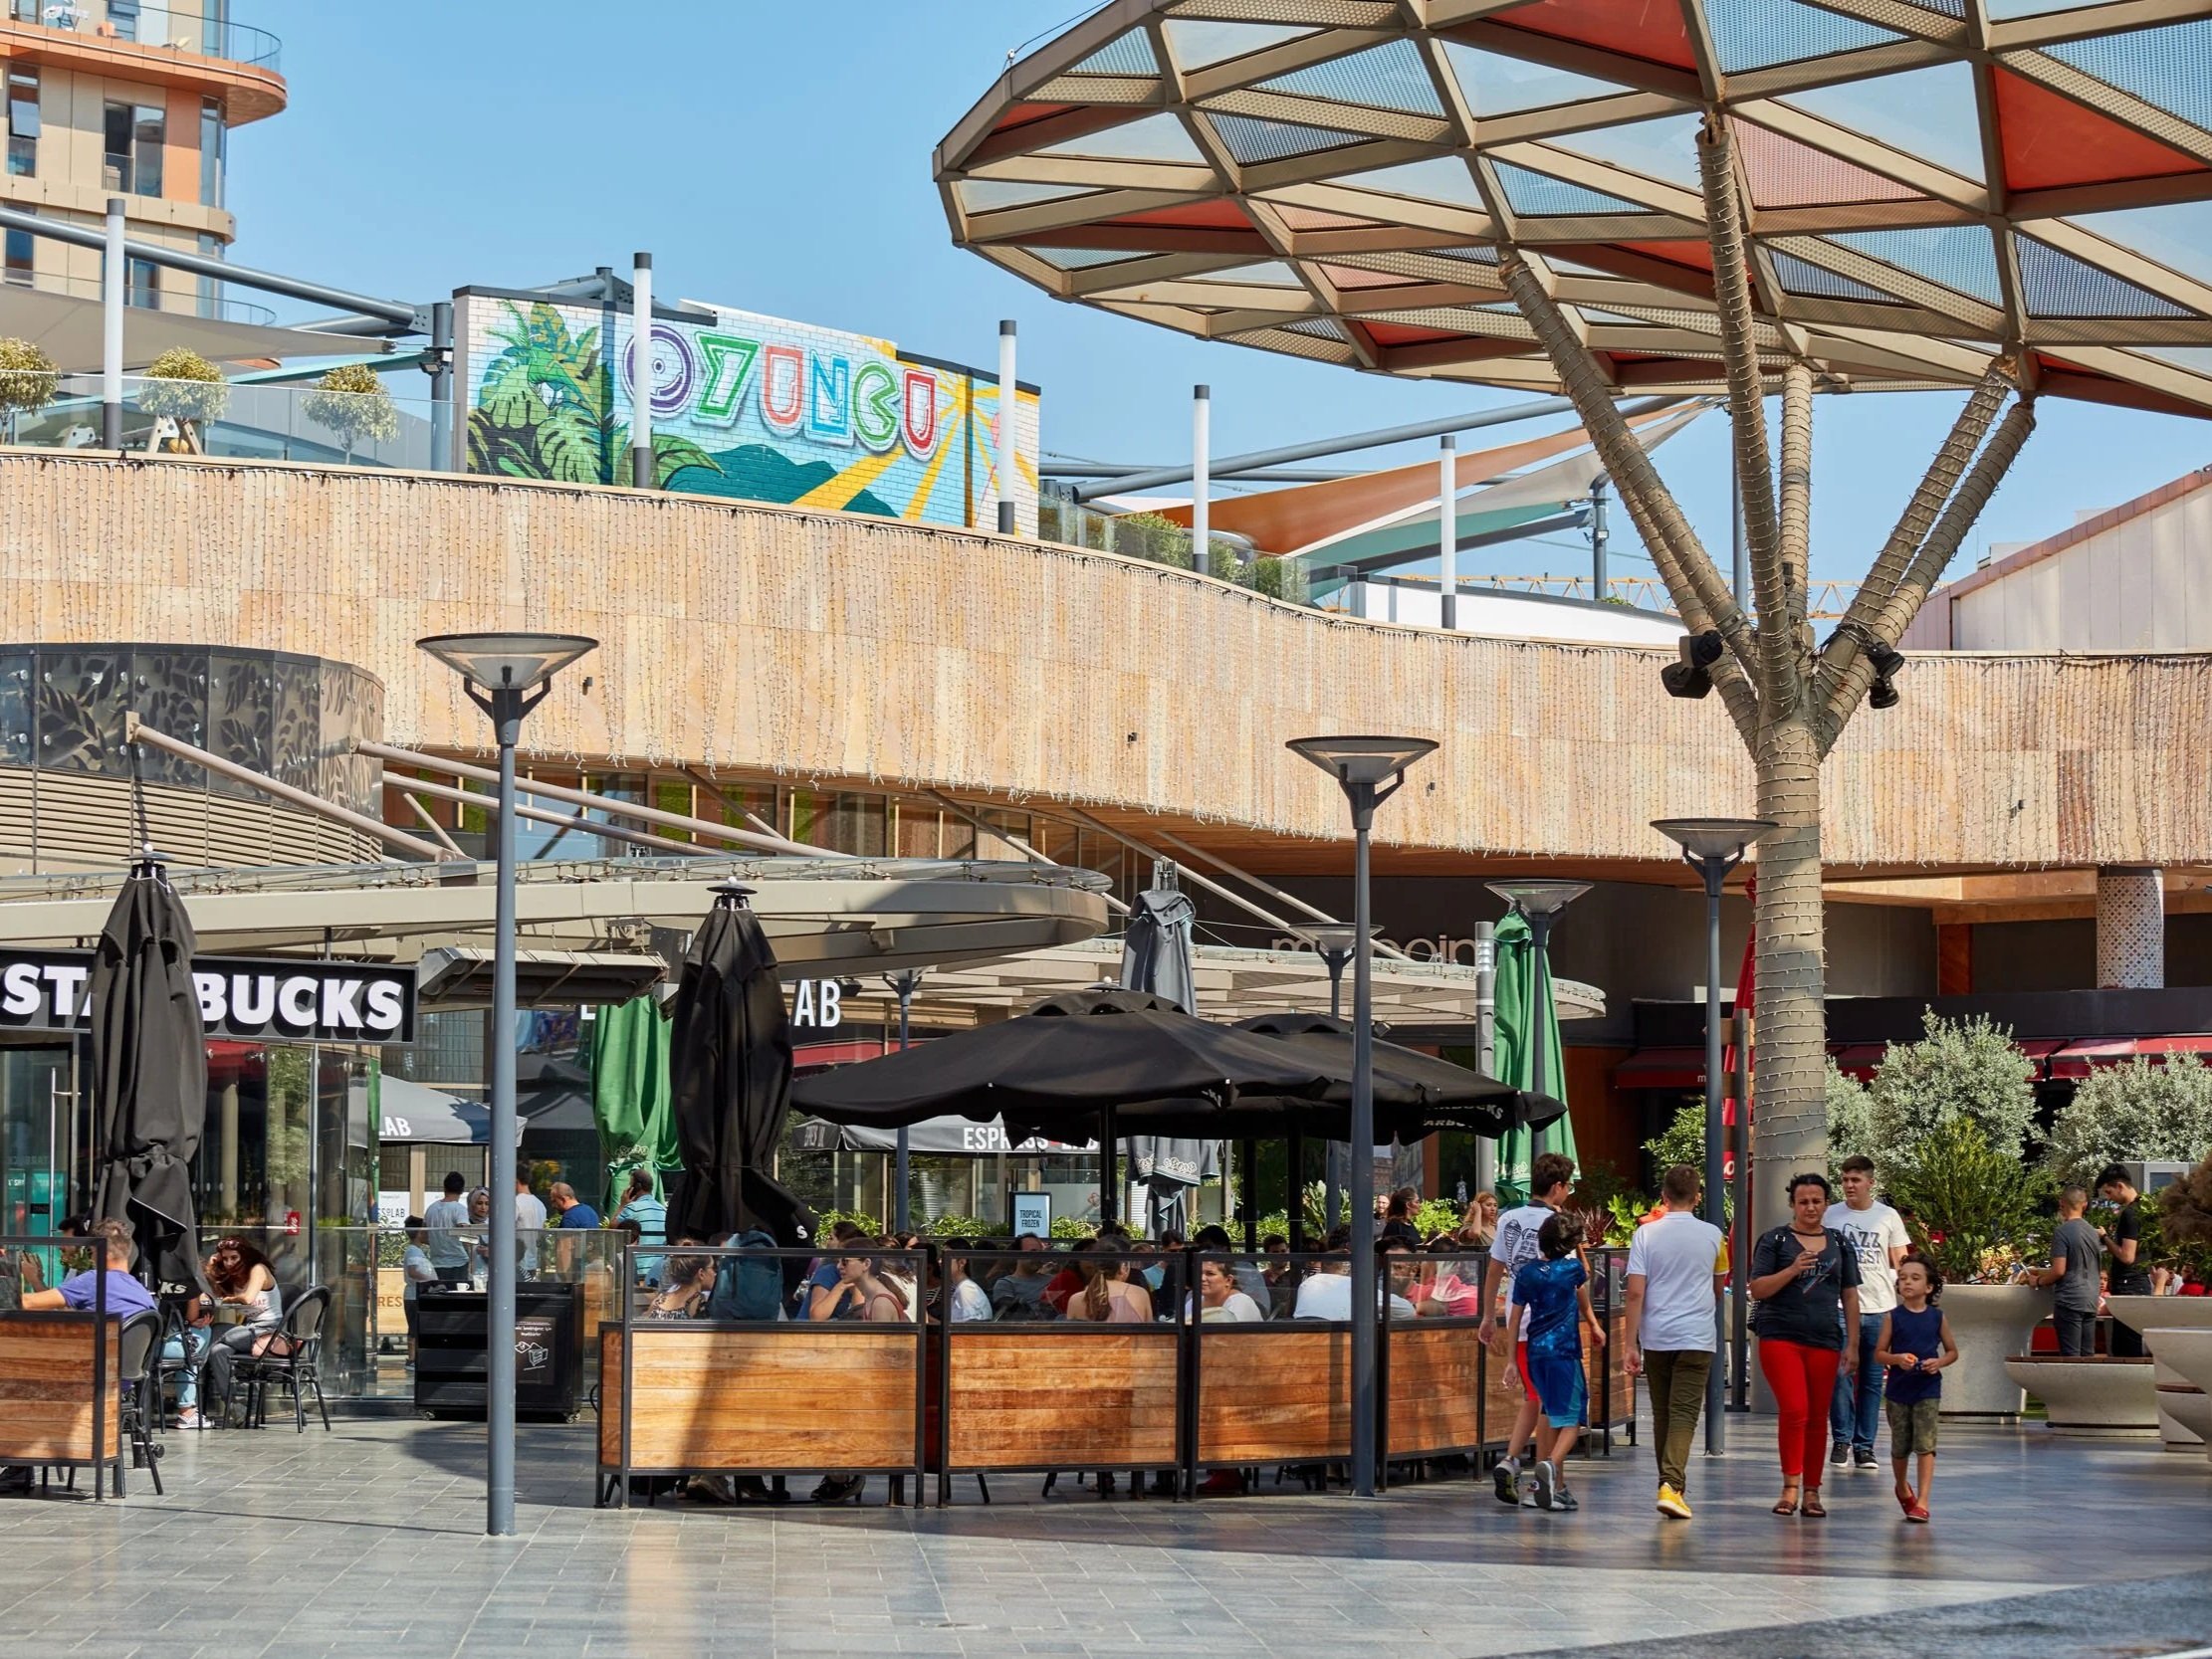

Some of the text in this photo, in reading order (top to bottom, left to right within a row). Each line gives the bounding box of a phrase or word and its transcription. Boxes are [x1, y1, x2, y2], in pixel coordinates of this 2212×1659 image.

[2, 962, 404, 1030] STBUCKS
[1019, 1209, 1042, 1219] TROPICAL
[1021, 1219, 1040, 1228] FROZEN
[1848, 1231, 1880, 1248] AZZ
[1857, 1249, 1881, 1264] EST
